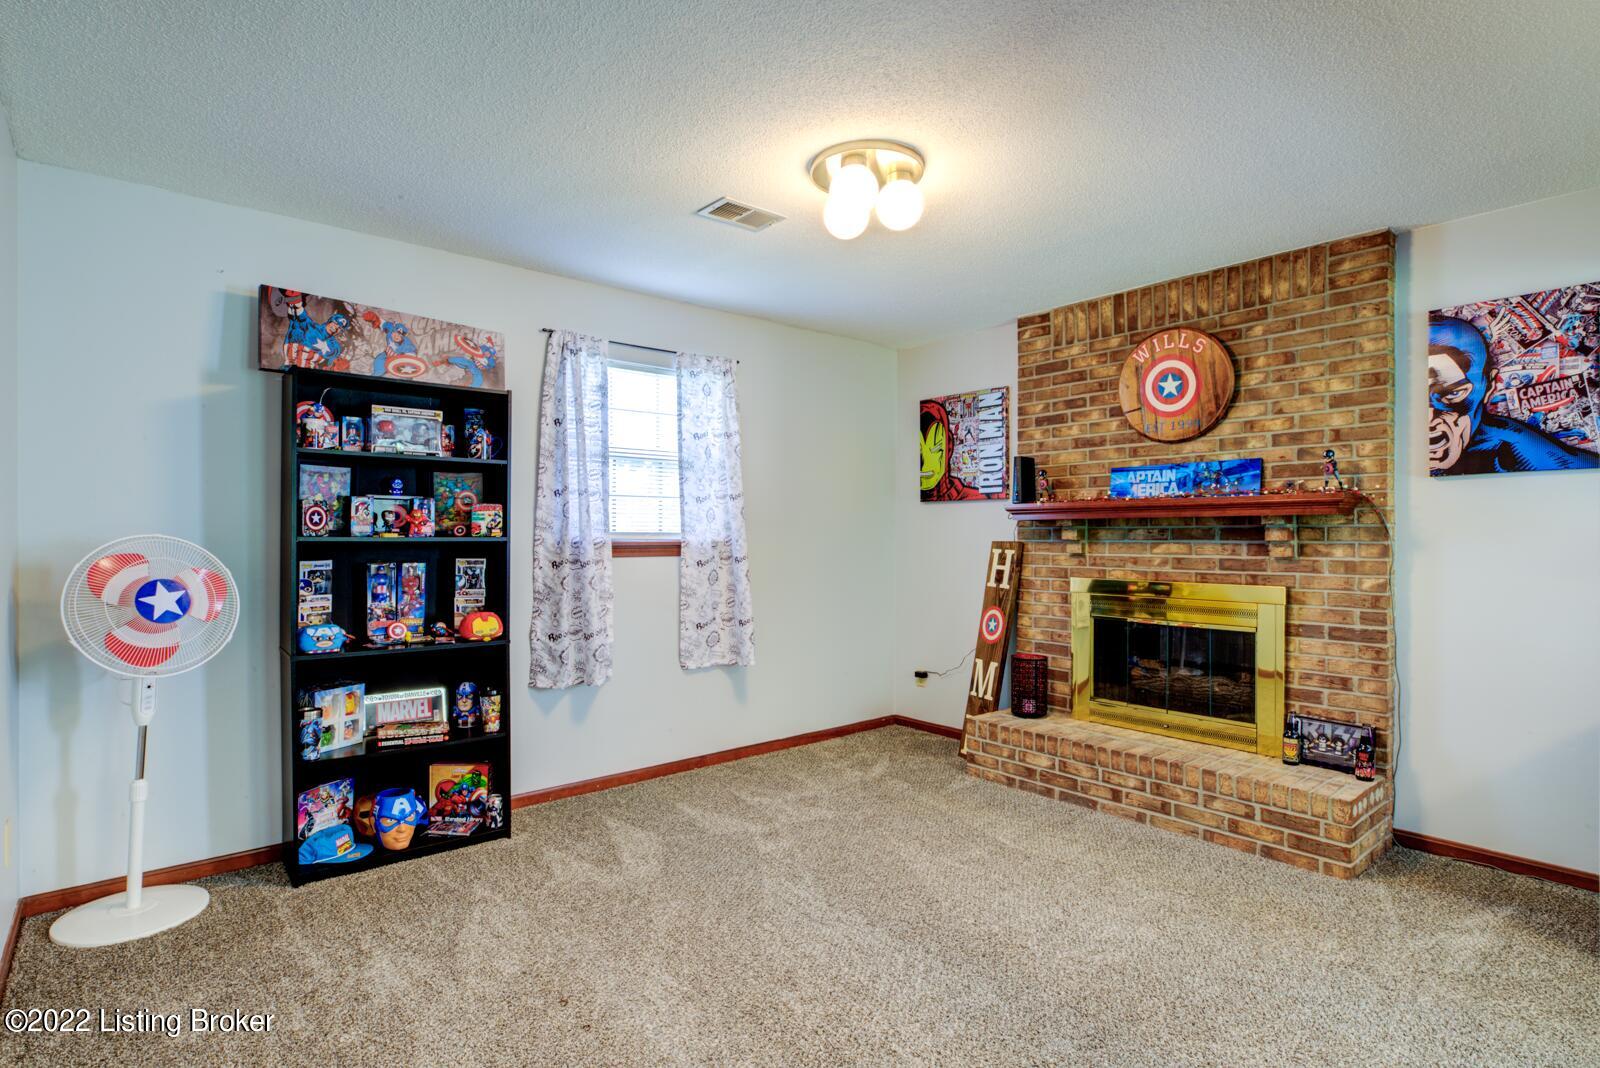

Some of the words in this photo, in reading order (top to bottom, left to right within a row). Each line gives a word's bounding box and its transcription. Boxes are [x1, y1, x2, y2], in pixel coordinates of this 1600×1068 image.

[1132, 333, 1207, 363] WILLS
[1519, 377, 1574, 399] CAPTAIN
[1520, 389, 1579, 412] AMERICA
[978, 391, 1004, 441] MAN
[978, 443, 1003, 494] IRON
[377, 698, 432, 724] MARVEL
